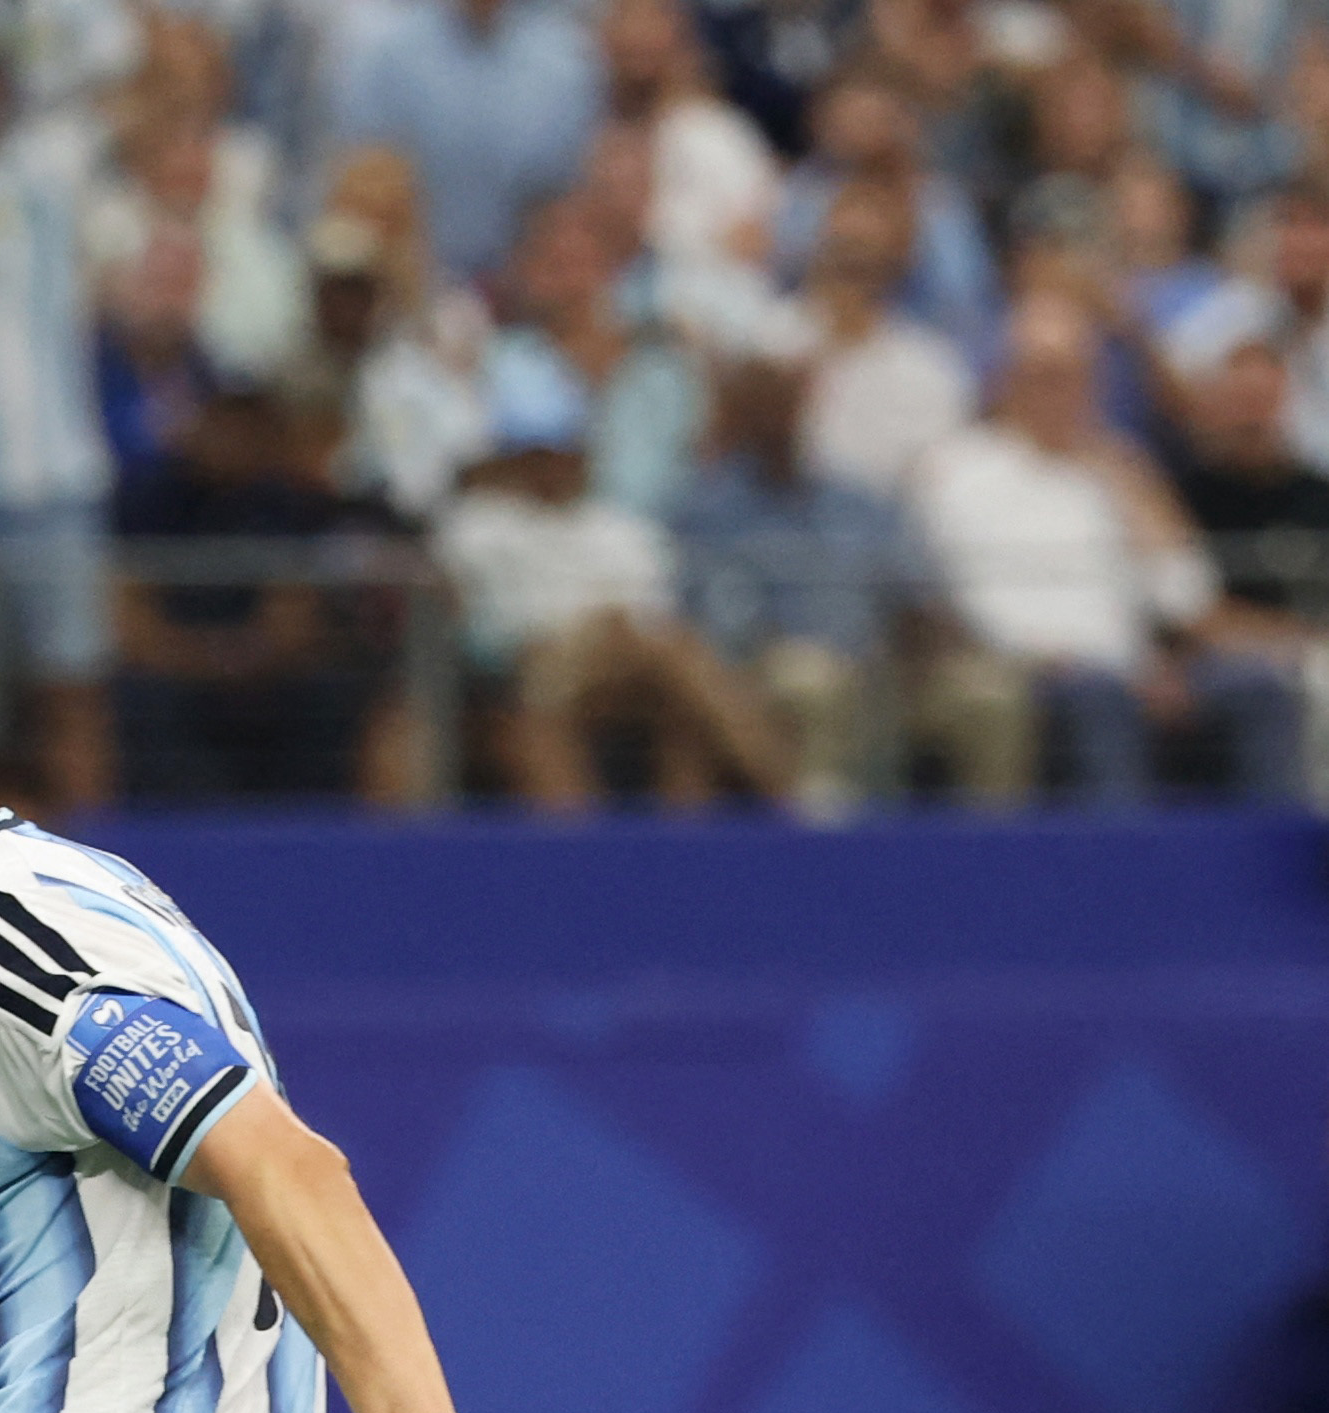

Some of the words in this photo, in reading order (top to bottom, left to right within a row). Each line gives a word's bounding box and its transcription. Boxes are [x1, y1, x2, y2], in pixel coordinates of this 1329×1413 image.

[84, 1014, 163, 1092] FOOTBALL
[101, 1024, 182, 1111] UNITES
[122, 1099, 149, 1132] the
[139, 1038, 204, 1099] World
